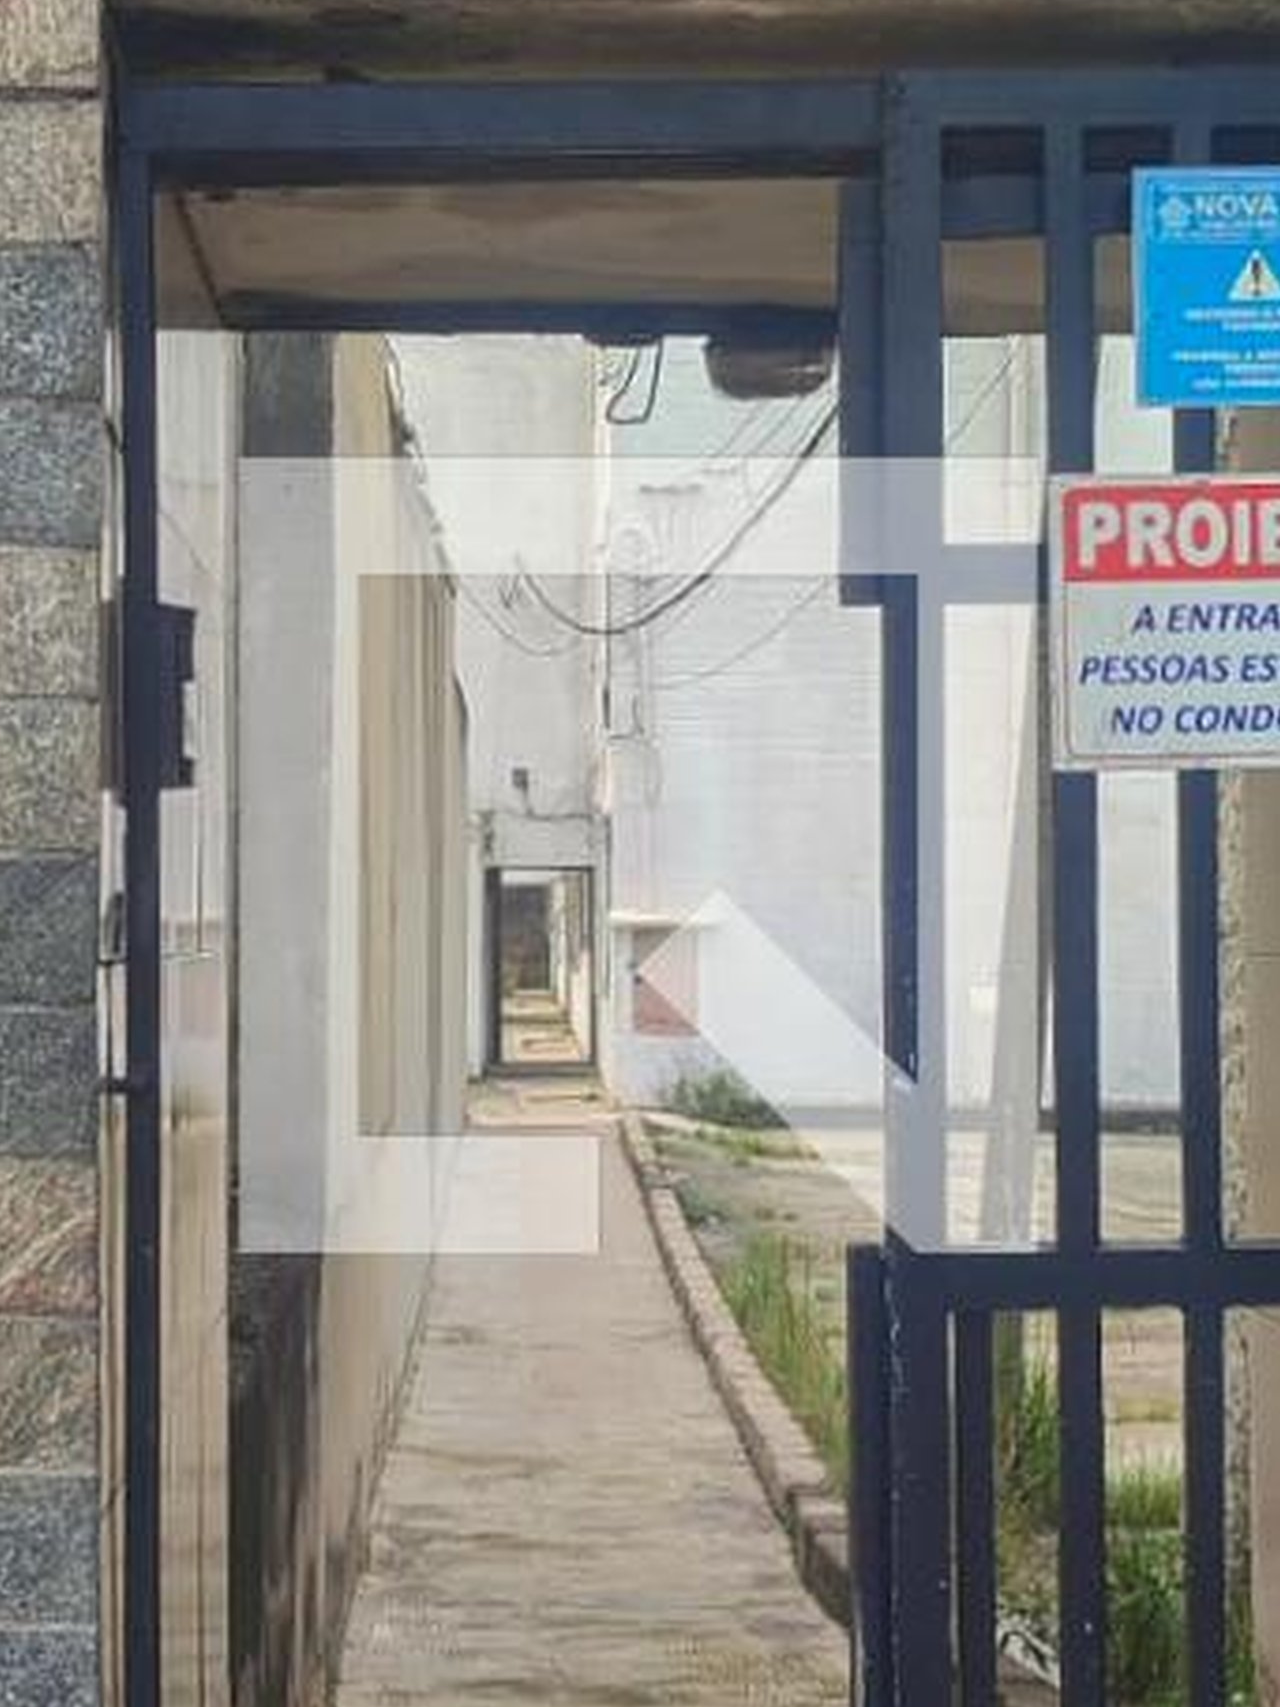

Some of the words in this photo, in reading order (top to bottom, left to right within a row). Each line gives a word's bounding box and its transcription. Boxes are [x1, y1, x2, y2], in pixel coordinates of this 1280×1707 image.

[1194, 193, 1279, 217] NOVA
[1131, 606, 1156, 634] A
[1079, 654, 1230, 685] PESSOAS
[1110, 705, 1165, 735] NO
